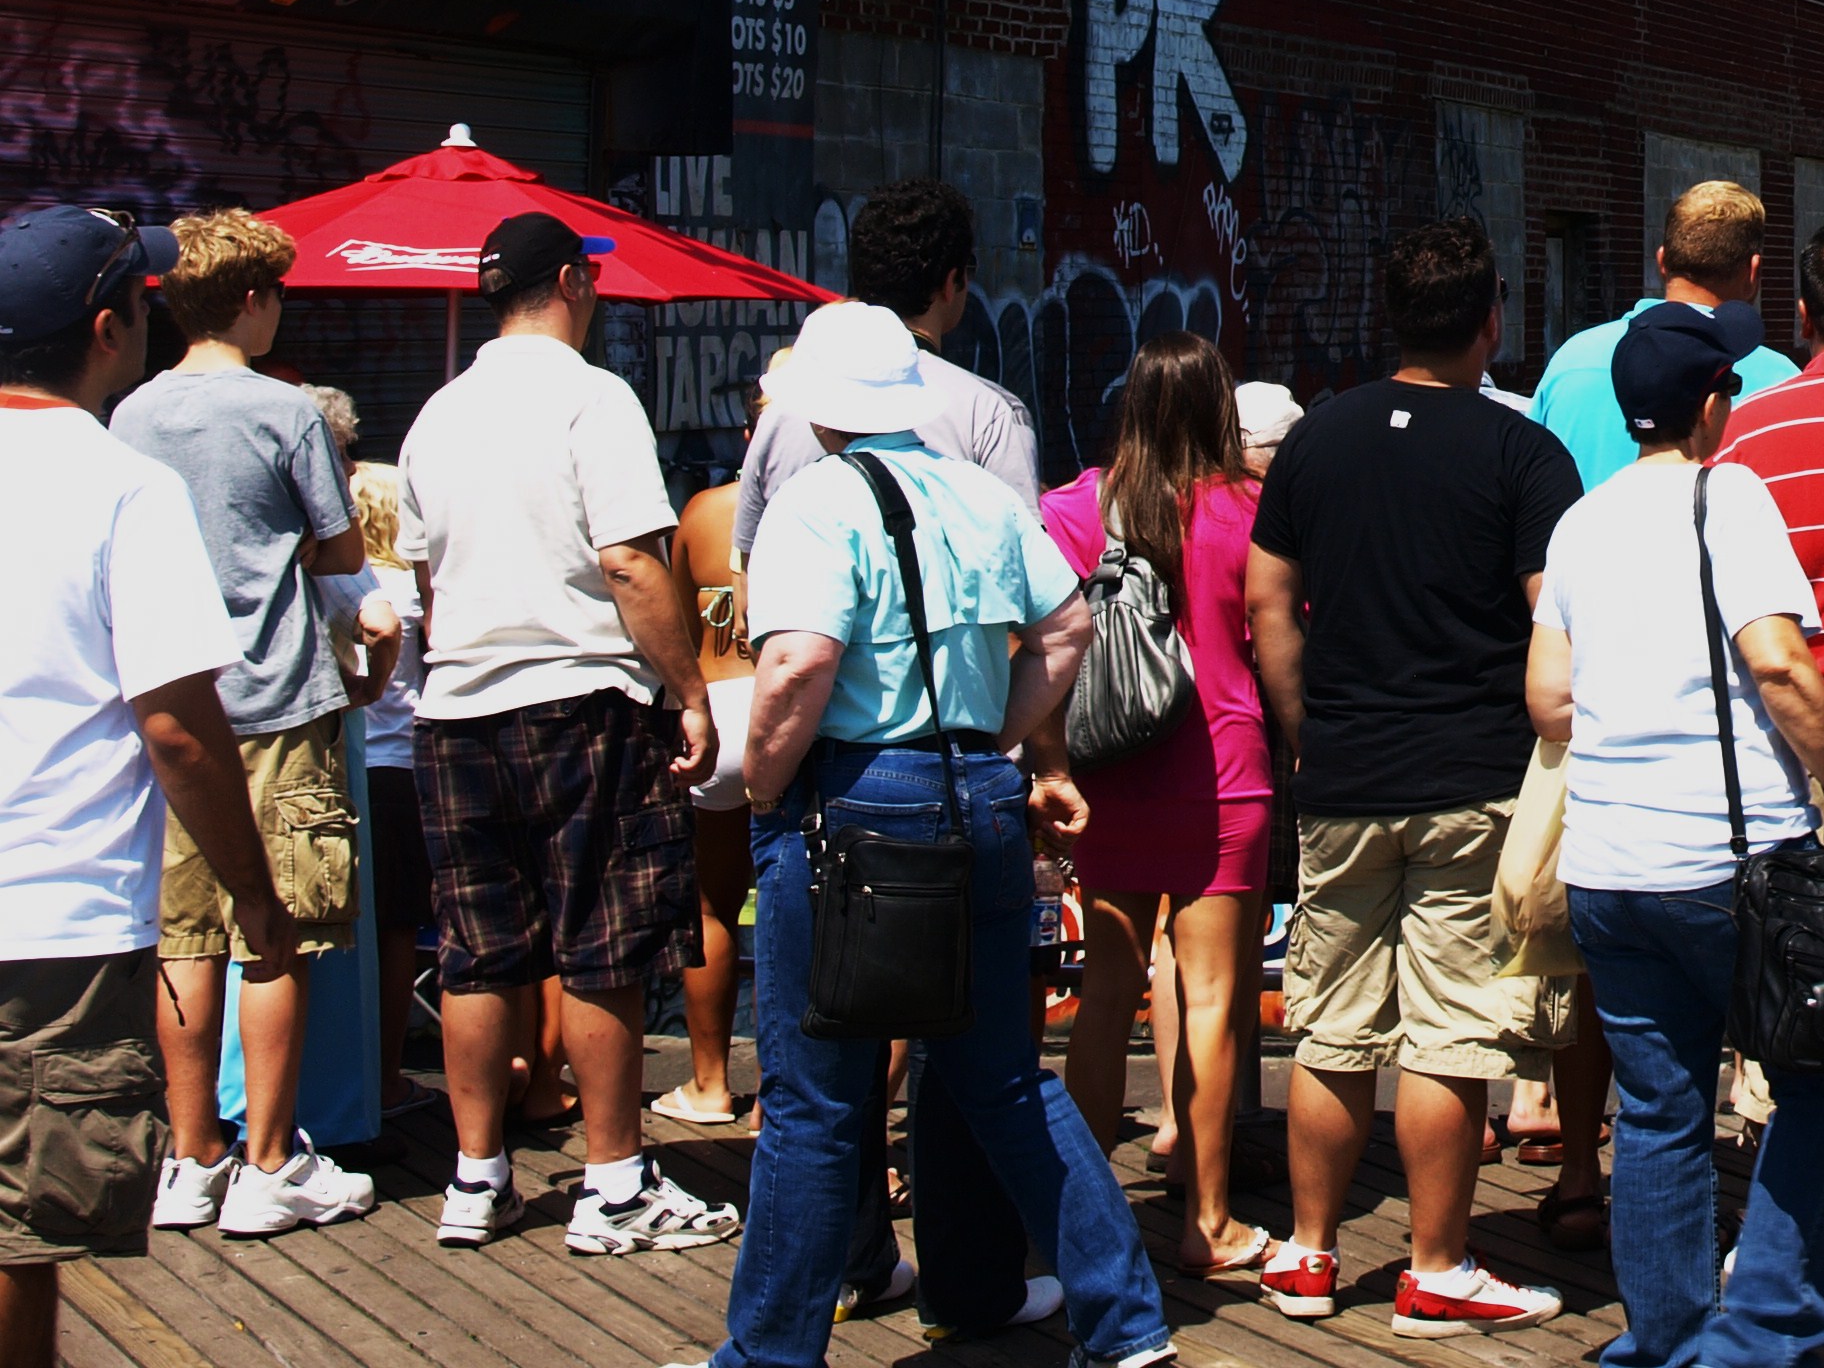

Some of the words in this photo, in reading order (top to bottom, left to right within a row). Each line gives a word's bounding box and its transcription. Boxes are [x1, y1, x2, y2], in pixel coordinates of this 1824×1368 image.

[731, 15, 766, 51] OTS
[771, 16, 808, 57] $10
[731, 60, 766, 97] OTS
[770, 62, 805, 101] $20
[655, 154, 734, 217] LIVE
[655, 331, 798, 431] TARG
